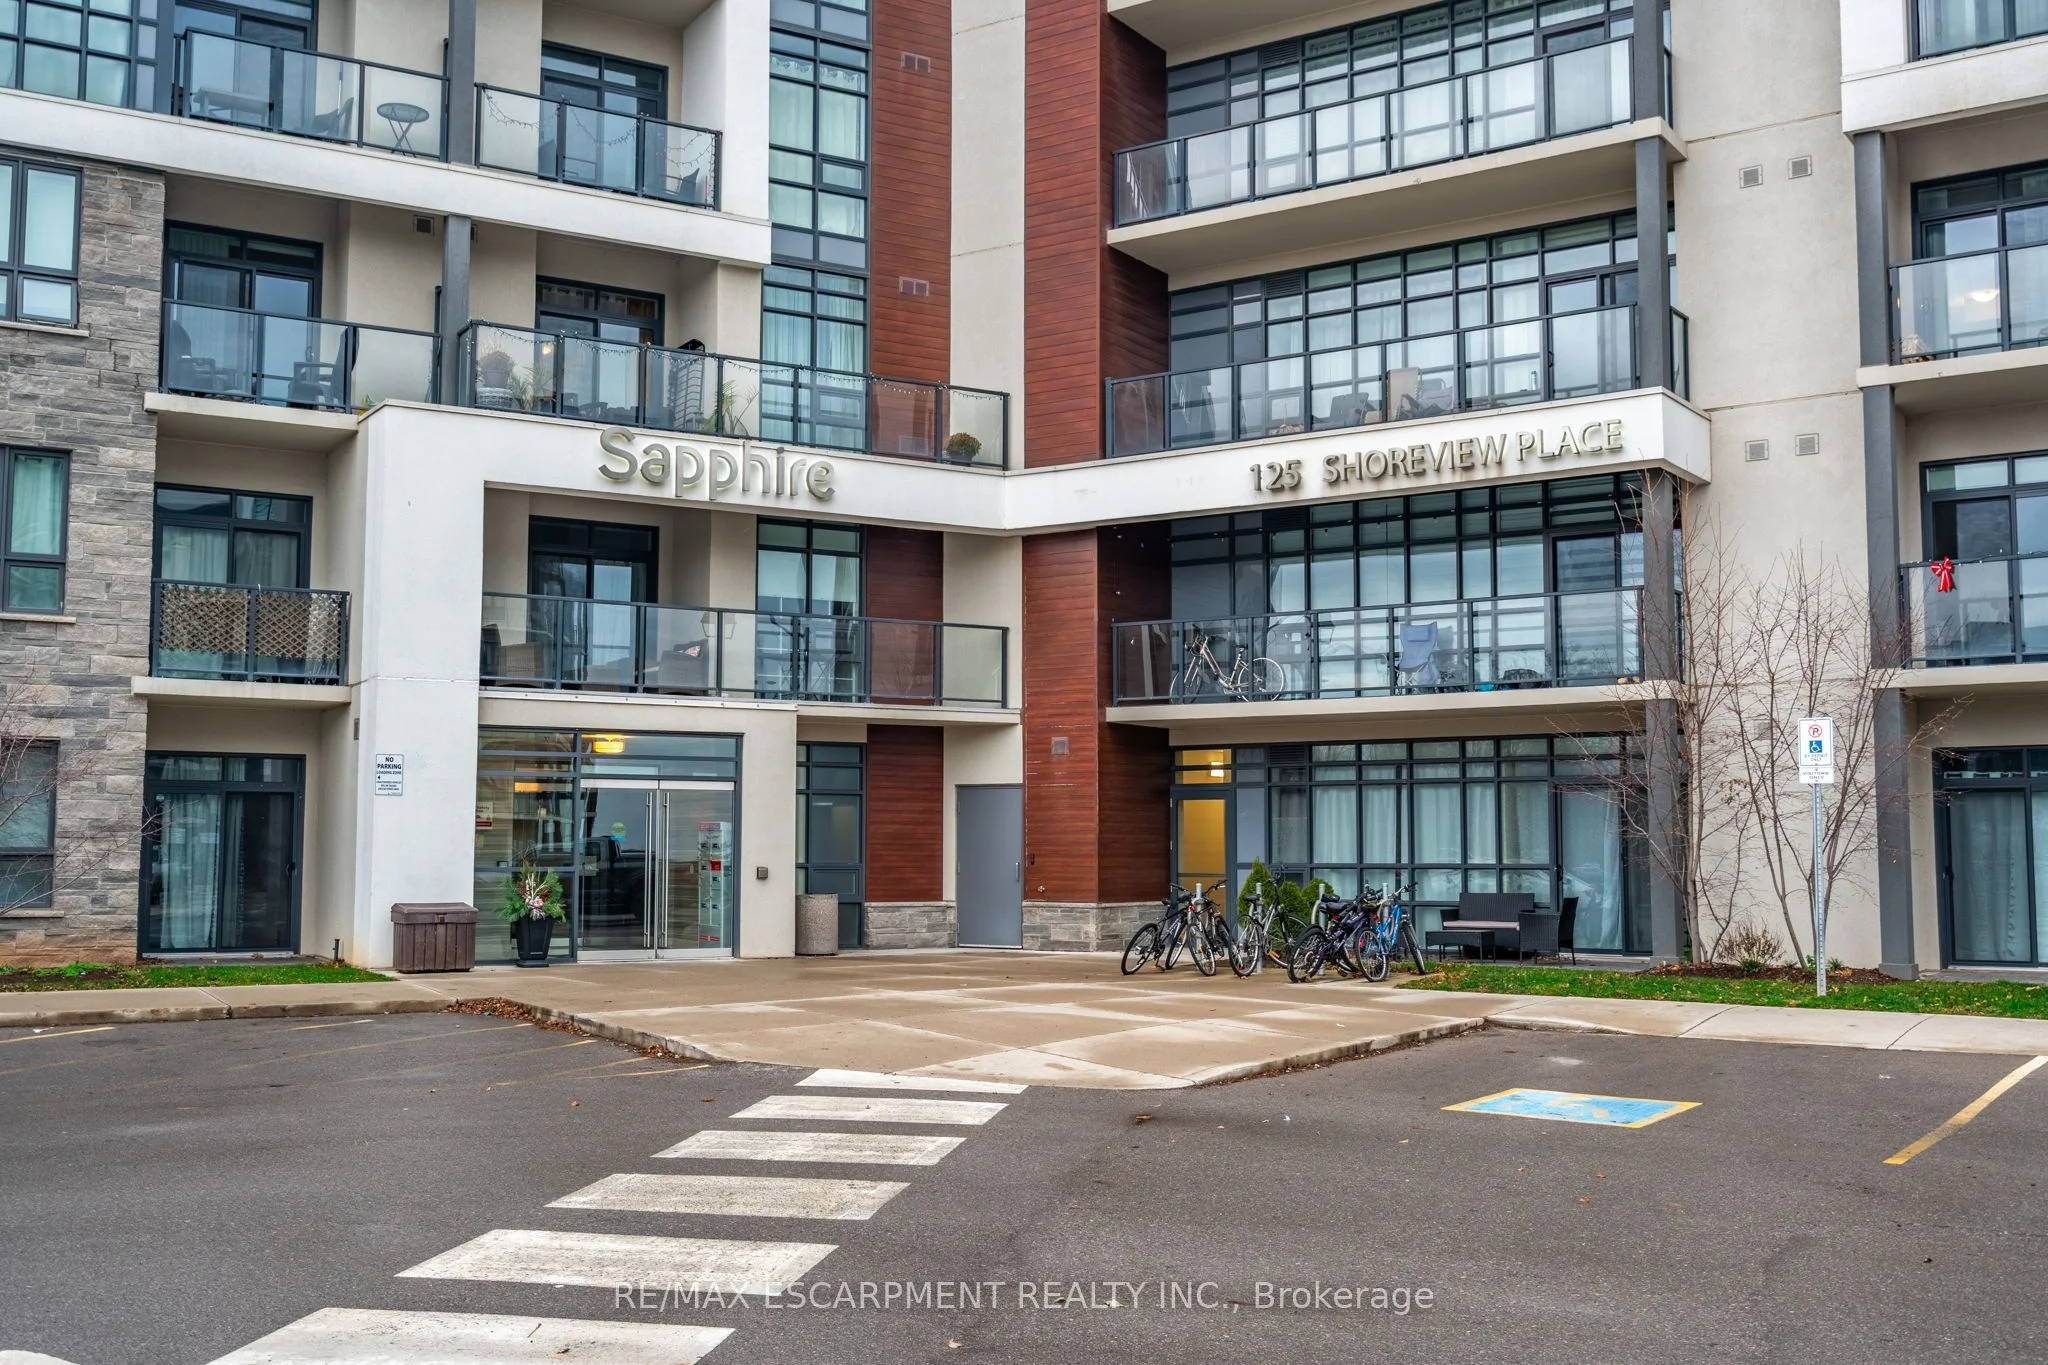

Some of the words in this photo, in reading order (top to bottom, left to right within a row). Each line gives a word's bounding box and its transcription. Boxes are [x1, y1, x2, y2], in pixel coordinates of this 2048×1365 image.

[598, 426, 836, 500] Sapphire
[1250, 459, 1303, 492] 125
[1322, 433, 1507, 484] SHOREVIEW
[1515, 419, 1624, 462] PLACE
